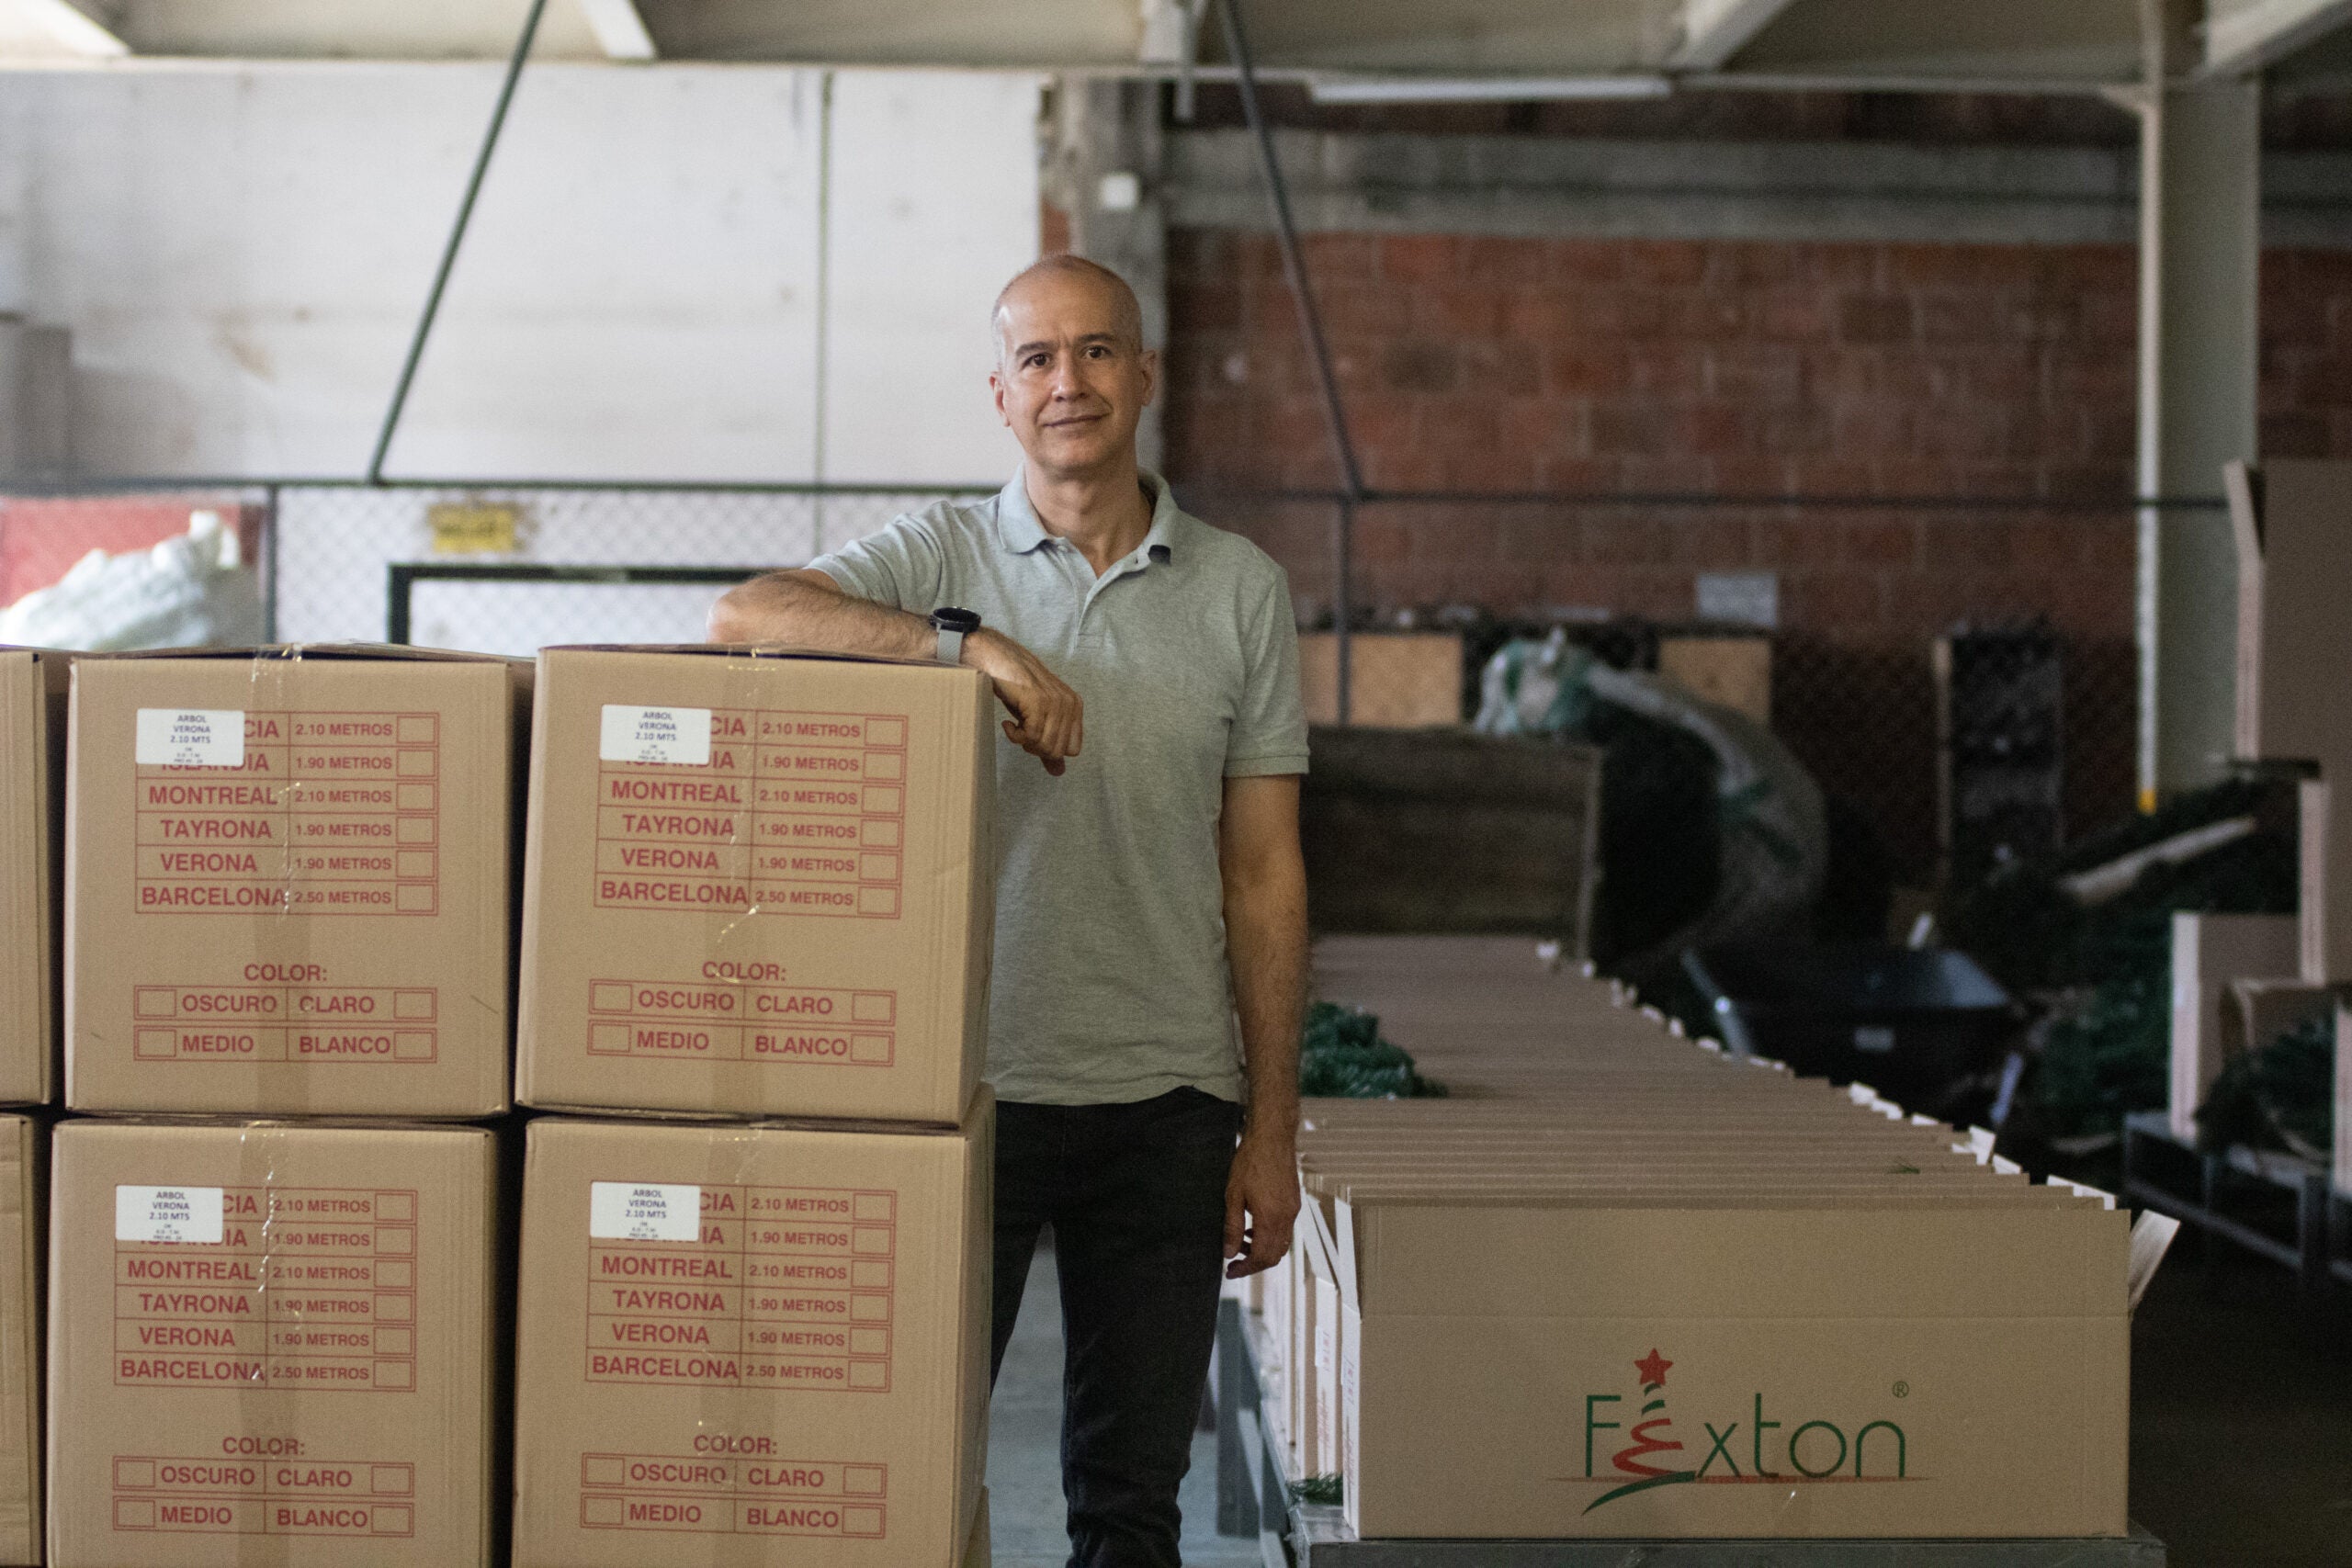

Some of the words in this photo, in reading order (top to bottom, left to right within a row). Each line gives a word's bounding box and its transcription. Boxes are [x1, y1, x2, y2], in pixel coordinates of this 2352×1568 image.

[643, 712, 672, 720] ARBOL
[294, 722, 325, 736] 2.10
[329, 724, 393, 737] METROS
[762, 722, 793, 736] 2.10
[796, 723, 861, 738] METROS
[295, 756, 325, 769] 1.90
[329, 757, 392, 770] METROS
[762, 756, 792, 770] 1.90
[795, 757, 860, 772] METROS
[148, 785, 279, 806] MONTREAL
[294, 789, 325, 803] 2.10
[329, 791, 392, 804] METROS
[611, 780, 742, 805] MONTREAL
[758, 789, 790, 803] 2.10
[793, 790, 858, 806] METROS
[160, 819, 273, 839] TAYRONA
[295, 823, 325, 837] 1.90
[329, 824, 392, 838] METROS
[622, 813, 735, 837] TAYRONA
[758, 823, 789, 836] 1.90
[792, 824, 857, 839] METROS
[160, 853, 258, 873] VERONA
[295, 857, 324, 871] 1.90
[329, 857, 392, 871] METROS
[621, 847, 719, 870] VERONA
[757, 856, 788, 870] 1.90
[790, 857, 855, 873] METROS
[141, 886, 287, 907] BARCELONA
[293, 891, 324, 905] 2.50
[329, 891, 392, 905] METROS
[601, 880, 749, 905] BARCELONA
[755, 890, 786, 904] 2.50
[788, 891, 854, 907] METROS
[243, 964, 328, 983] COLOR:
[701, 961, 786, 982] COLOR:
[182, 994, 277, 1013] OSCURO
[299, 995, 376, 1014] CLARO
[638, 990, 735, 1011] OSCURO
[756, 995, 834, 1014] CLARO
[182, 1034, 254, 1053] MEDIO
[299, 1035, 390, 1055] BLANCO
[636, 1030, 710, 1051] MEDIO
[754, 1034, 848, 1056] BLANCO
[629, 1200, 666, 1208] VERONA
[633, 1190, 662, 1198] ARBOL
[273, 1199, 304, 1213] 2.10
[307, 1200, 371, 1214] METROS
[751, 1198, 782, 1212] 2.10
[785, 1199, 850, 1213] METROS
[274, 1233, 304, 1247] 1.90
[307, 1233, 370, 1247] METROS
[751, 1231, 781, 1245] 1.90
[784, 1232, 848, 1247] METROS
[128, 1259, 256, 1281] MONTREAL
[273, 1266, 304, 1280] 2.10
[307, 1267, 370, 1280] METROS
[601, 1256, 732, 1280] MONTREAL
[749, 1265, 780, 1278] 2.10
[783, 1265, 847, 1280] METROS
[139, 1292, 251, 1314] TAYRONA
[273, 1299, 303, 1313] 1.90
[306, 1300, 370, 1314] METROS
[612, 1289, 726, 1313] TAYRONA
[748, 1298, 778, 1312] 1.90
[782, 1298, 846, 1314] METROS
[139, 1326, 236, 1348] VERONA
[273, 1332, 303, 1346] 1.90
[306, 1333, 370, 1348] METROS
[611, 1323, 710, 1346] VERONA
[747, 1331, 778, 1345] 1.90
[780, 1332, 845, 1348] METROS
[120, 1359, 265, 1382] BARCELONA
[272, 1366, 303, 1380] 2.50
[306, 1366, 370, 1381] METROS
[592, 1356, 740, 1380] BARCELONA
[745, 1364, 776, 1378] 2.50
[779, 1365, 844, 1380] METROS
[221, 1437, 306, 1456] COLOR:
[693, 1435, 778, 1455] COLOR:
[160, 1466, 256, 1486] OSCURO
[277, 1469, 353, 1488] CLARO
[630, 1463, 727, 1484] OSCURO
[748, 1468, 825, 1488] CLARO
[160, 1506, 232, 1526] MEDIO
[277, 1508, 368, 1529] BLANCO
[629, 1504, 702, 1524] MEDIO
[747, 1507, 839, 1529] BLANCO
